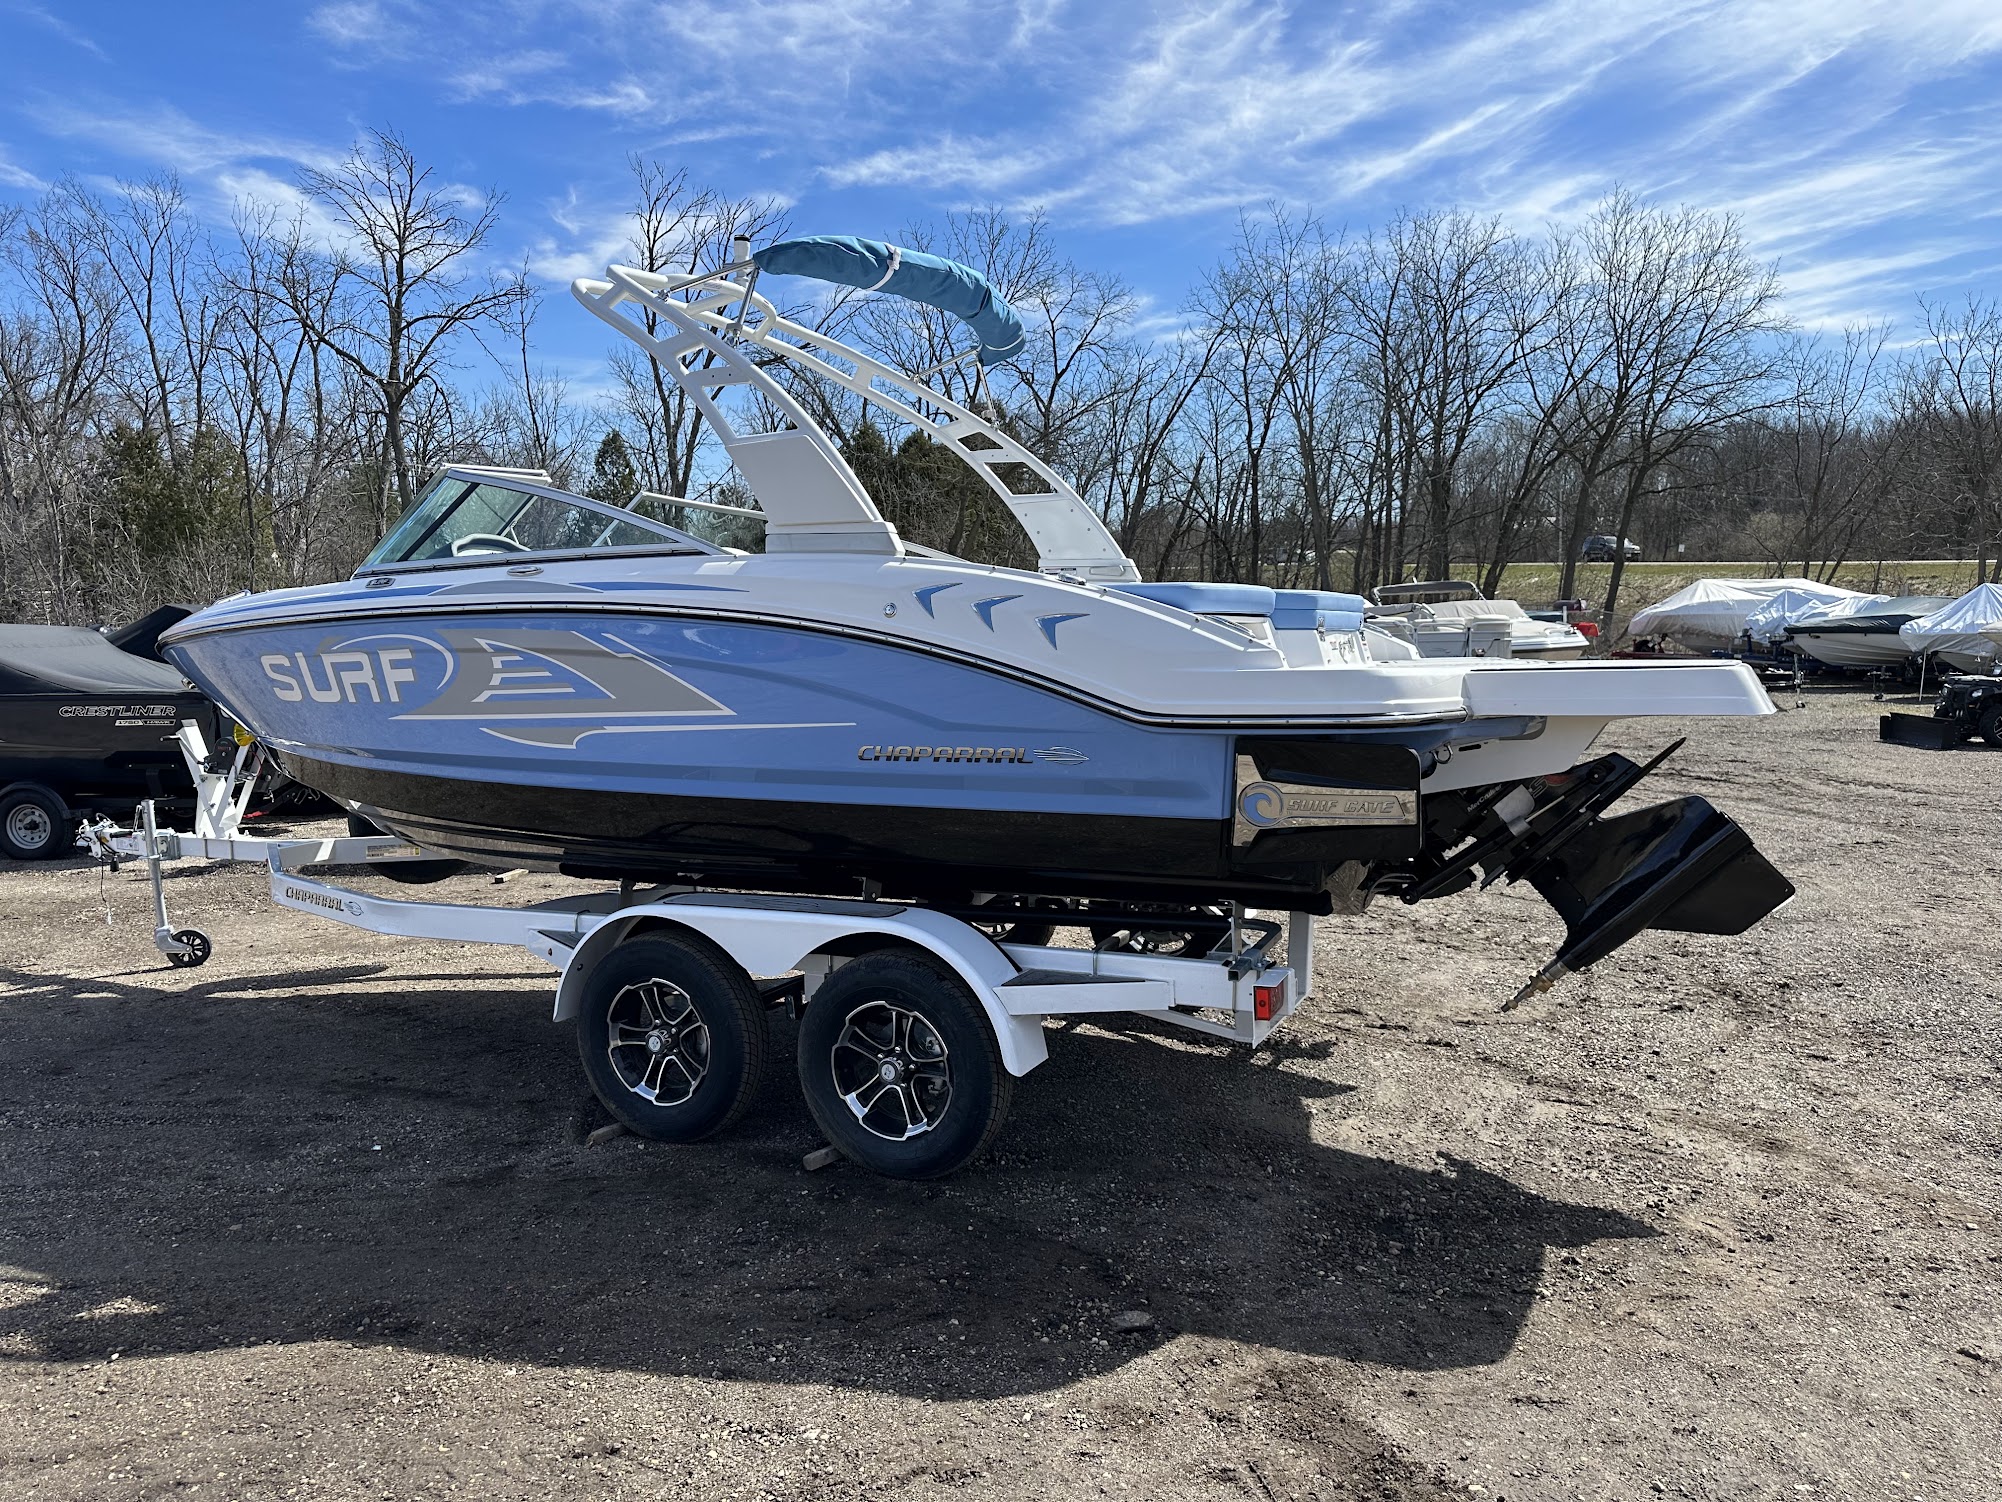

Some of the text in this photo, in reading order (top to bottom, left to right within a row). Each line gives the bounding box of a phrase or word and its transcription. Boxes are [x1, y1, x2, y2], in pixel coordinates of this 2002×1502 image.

[260, 649, 415, 703] SURF
[58, 705, 177, 718] CRESTLINER
[857, 745, 1034, 764] CHAPARRAL
[1286, 800, 1396, 814] SURF GATE
[1466, 784, 1503, 812] MerCruiser
[285, 886, 345, 912] CHAPARRAL
